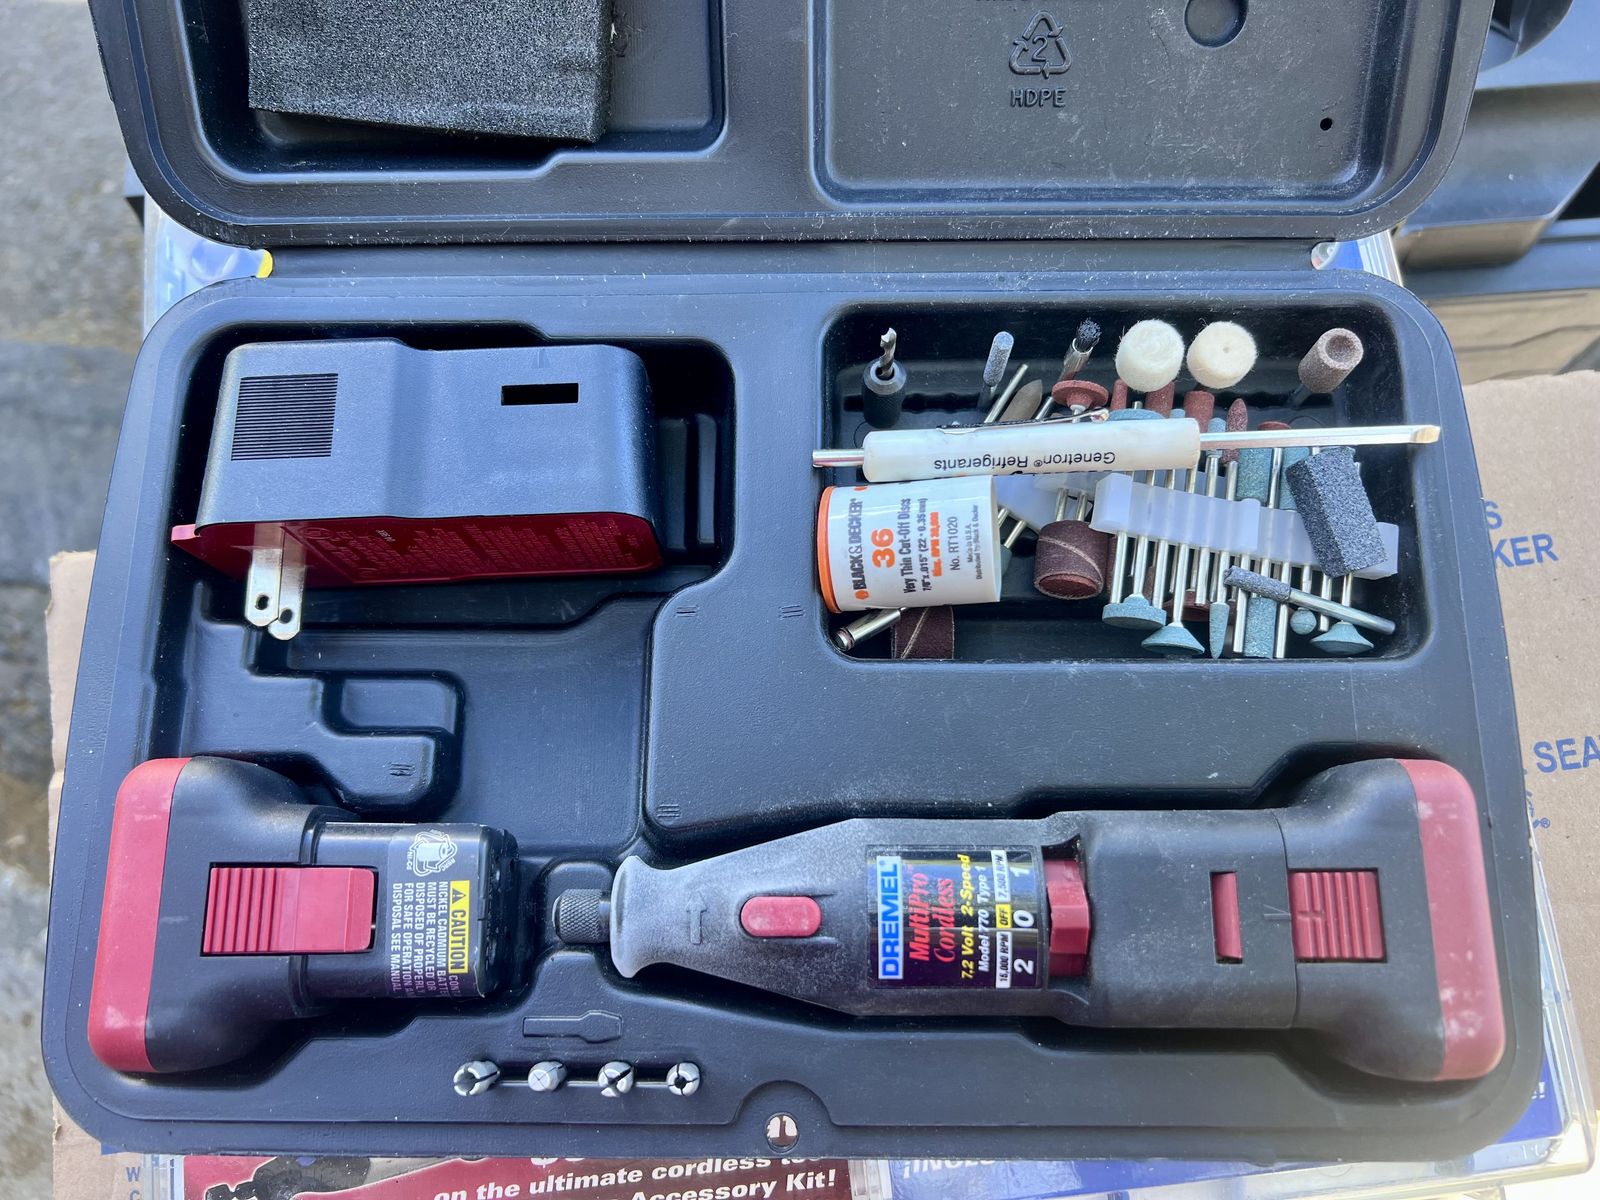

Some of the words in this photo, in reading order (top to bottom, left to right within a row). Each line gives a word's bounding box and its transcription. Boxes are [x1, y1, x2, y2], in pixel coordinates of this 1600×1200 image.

[1011, 88, 1066, 107] HDPE
[934, 454, 1028, 471] Refrigerants
[900, 498, 911, 519] Discs
[899, 522, 912, 554] Cut-Off
[948, 517, 960, 553] RT1020
[872, 529, 895, 568] 36
[901, 558, 913, 575] Thin
[951, 556, 961, 570] No.
[904, 579, 917, 593] Very
[1533, 735, 1600, 773] SEA
[958, 854, 975, 916] 2-Speed
[1010, 867, 1031, 877] 1
[404, 883, 414, 902] FOR
[427, 882, 436, 910] MUST
[438, 881, 448, 916] NICKEL
[977, 874, 990, 904] Type
[391, 883, 402, 930] DISPOSAL
[403, 904, 413, 929] SAFE
[414, 882, 425, 929] DISPOSED
[426, 912, 436, 925] BE
[1000, 908, 1009, 926] OFF
[1014, 910, 1035, 927] 0
[933, 878, 956, 963] Cordless
[978, 909, 989, 931] 770
[391, 933, 402, 951] SEE
[414, 932, 424, 945] OF
[436, 919, 447, 967] CADMIUM
[450, 910, 466, 970] CAUTION
[962, 925, 975, 955] Volt
[1000, 933, 1009, 954] RPM
[402, 932, 413, 986] OPERATION
[425, 928, 436, 979] RECYCLED
[979, 935, 990, 971] Model
[390, 954, 402, 992] MANUAL
[413, 948, 425, 993] PROPERLY
[962, 959, 976, 979] 7.2
[1000, 956, 1010, 982] 15,000
[1014, 959, 1034, 974] 2
[427, 981, 436, 991] OR
[476, 1182, 520, 1199] the
[529, 1168, 643, 1194] ultimate
[651, 1158, 771, 1180] cordless
[786, 1169, 836, 1191] Kit!
